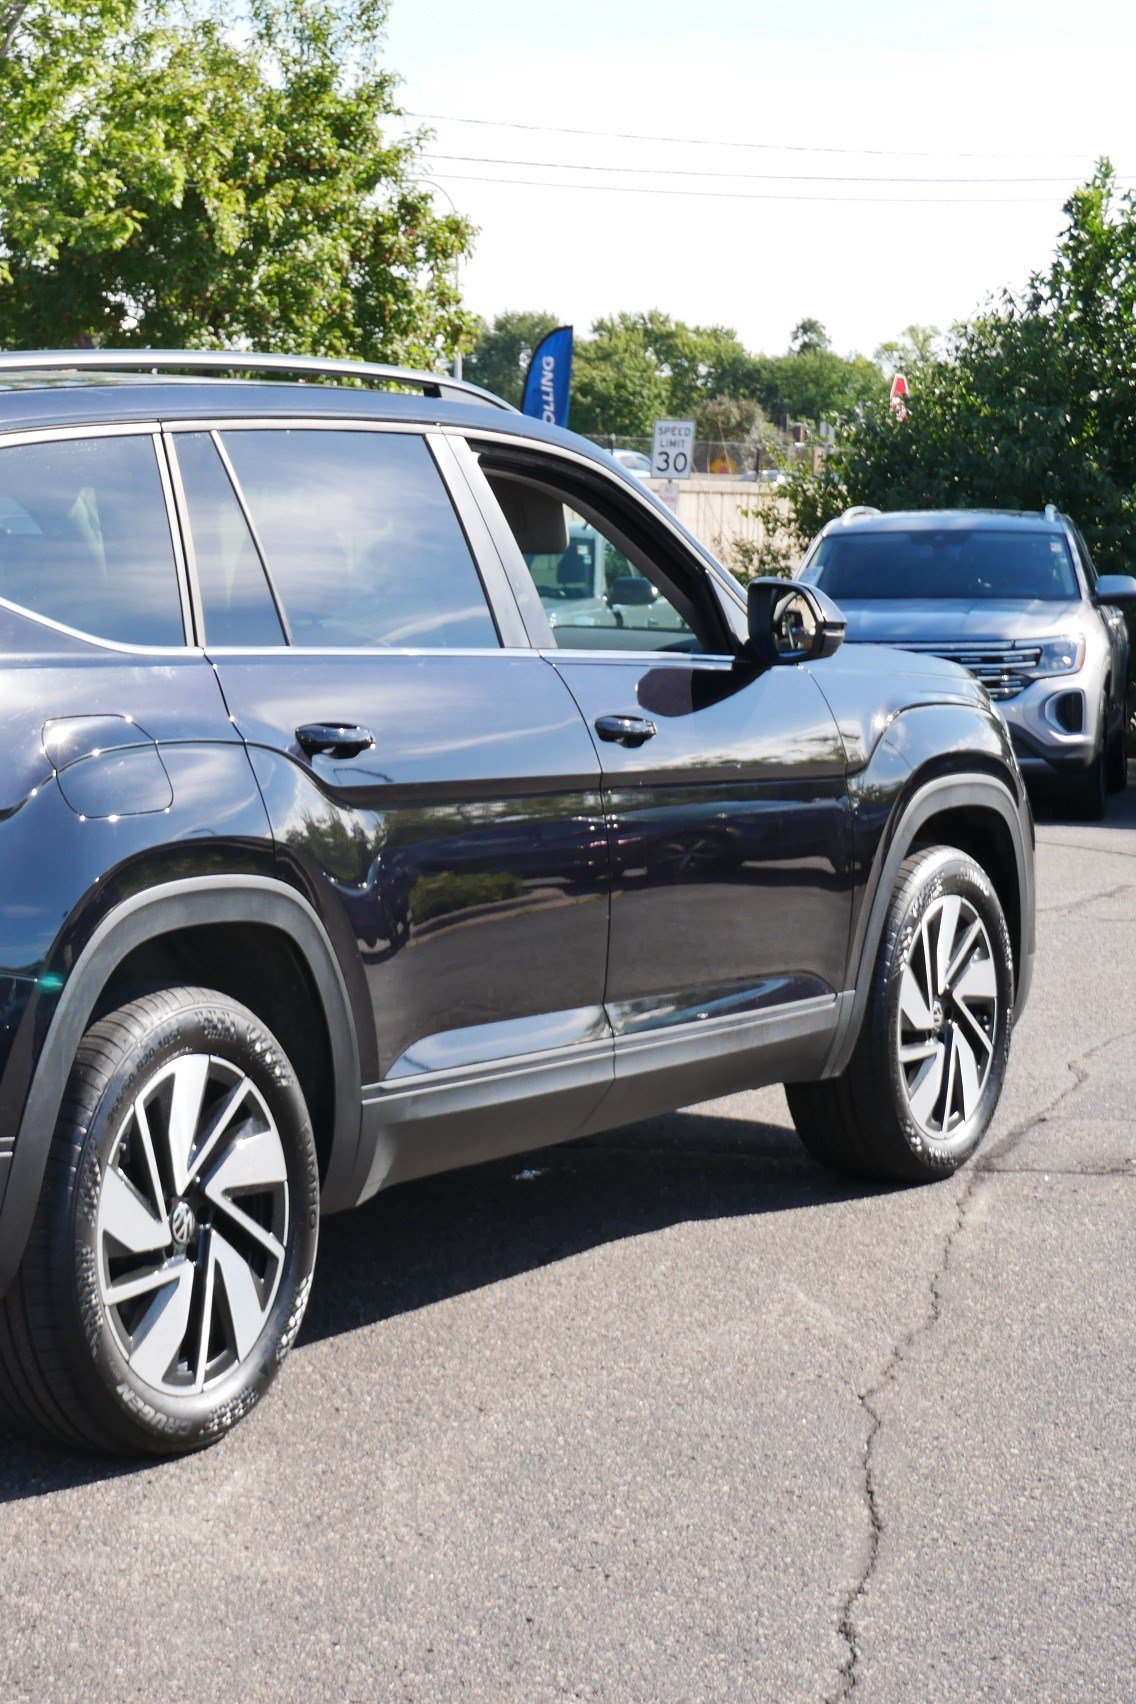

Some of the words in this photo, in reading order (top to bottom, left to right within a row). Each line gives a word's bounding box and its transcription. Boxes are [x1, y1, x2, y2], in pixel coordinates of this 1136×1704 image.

[658, 426, 691, 436] SPEED
[660, 439, 685, 448] LIMIT
[656, 451, 687, 472] 30
